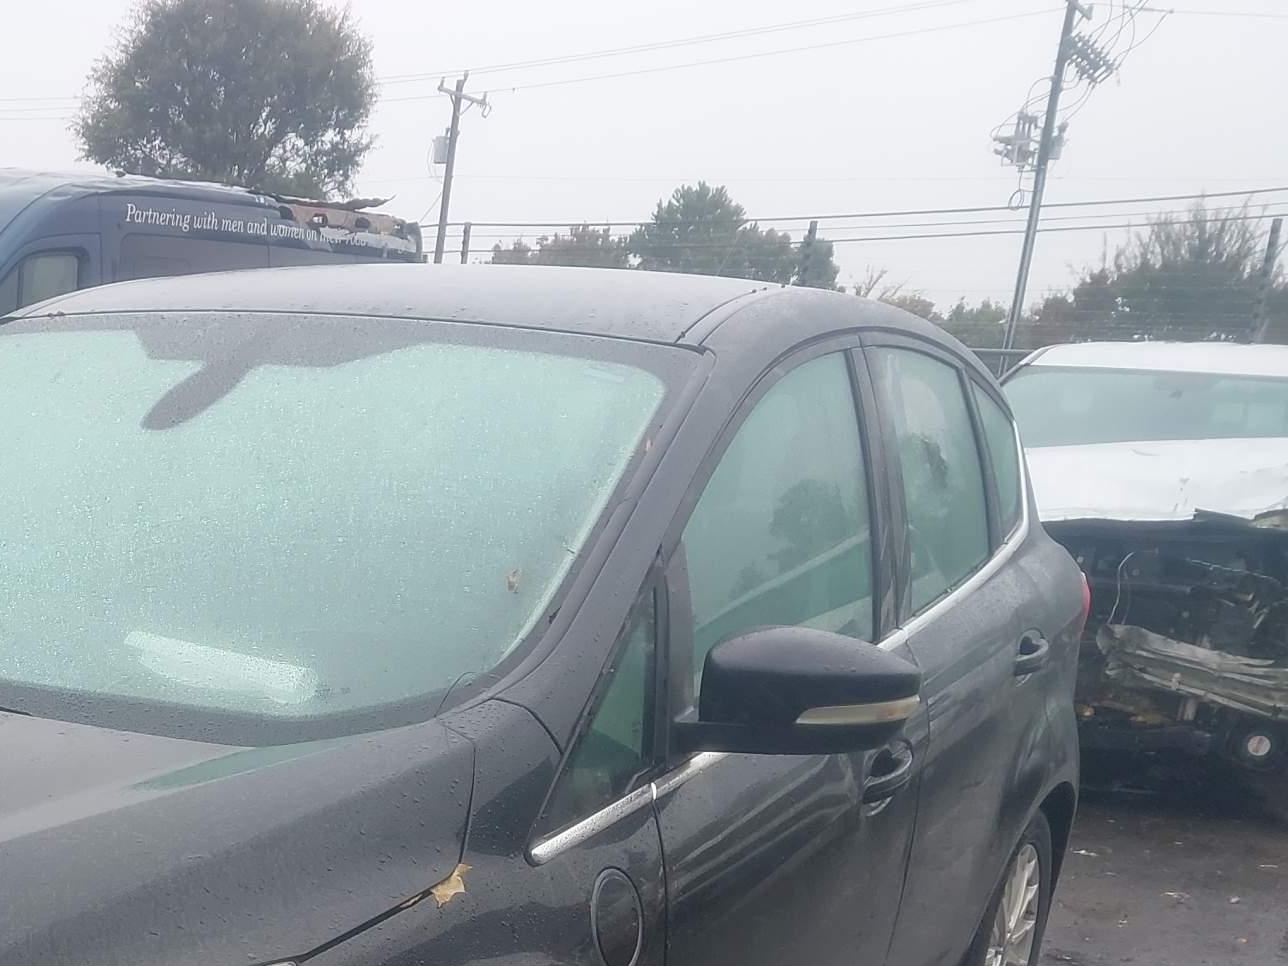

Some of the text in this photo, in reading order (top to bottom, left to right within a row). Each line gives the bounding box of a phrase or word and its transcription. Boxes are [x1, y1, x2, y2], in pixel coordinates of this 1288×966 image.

[126, 203, 192, 232] Partnering
[193, 211, 219, 231] with
[221, 217, 244, 233] men
[247, 217, 268, 236] and
[270, 224, 305, 241] women
[306, 229, 318, 242] on
